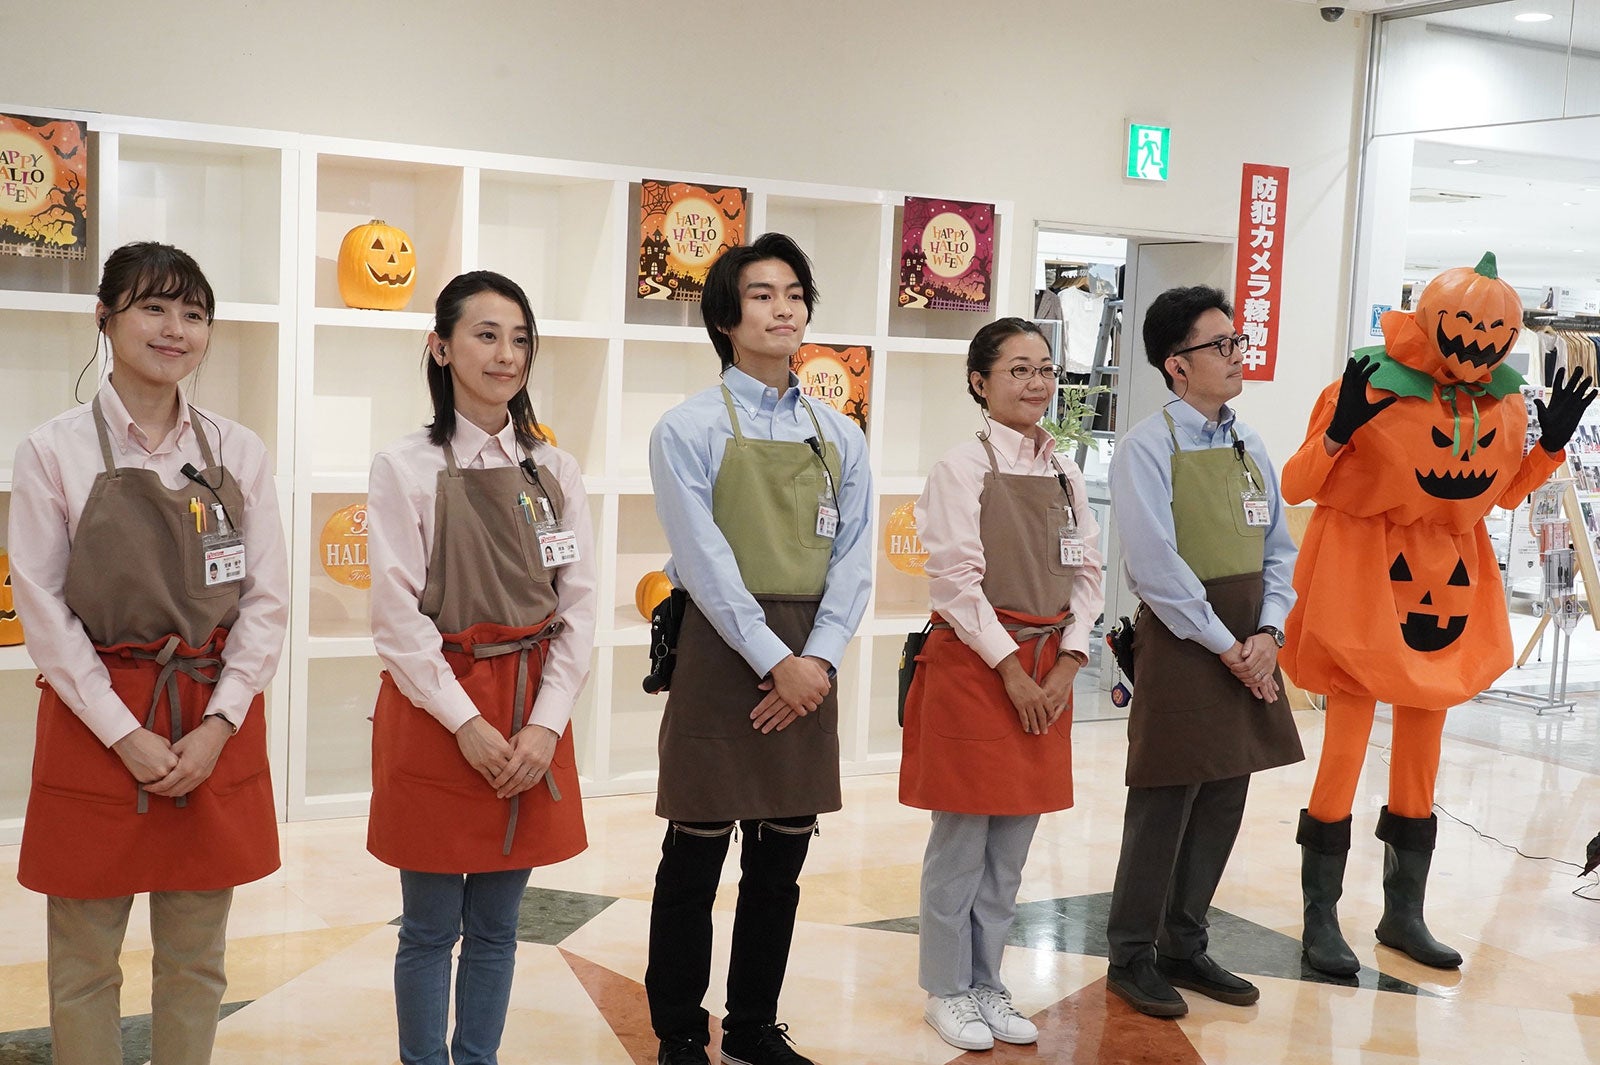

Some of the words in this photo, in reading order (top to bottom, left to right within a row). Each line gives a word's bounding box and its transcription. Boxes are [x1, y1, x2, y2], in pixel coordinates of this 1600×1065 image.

[0, 150, 43, 169] APPY
[0, 165, 45, 186] ALLO
[0, 182, 39, 203] EEN
[675, 212, 716, 228] HAPPY
[672, 227, 717, 242] HALLO
[933, 226, 968, 242] HAPPY
[676, 241, 712, 258] WEEN
[930, 240, 969, 255] HALLO
[932, 252, 965, 269] WEEN
[805, 371, 843, 386] HAPPY
